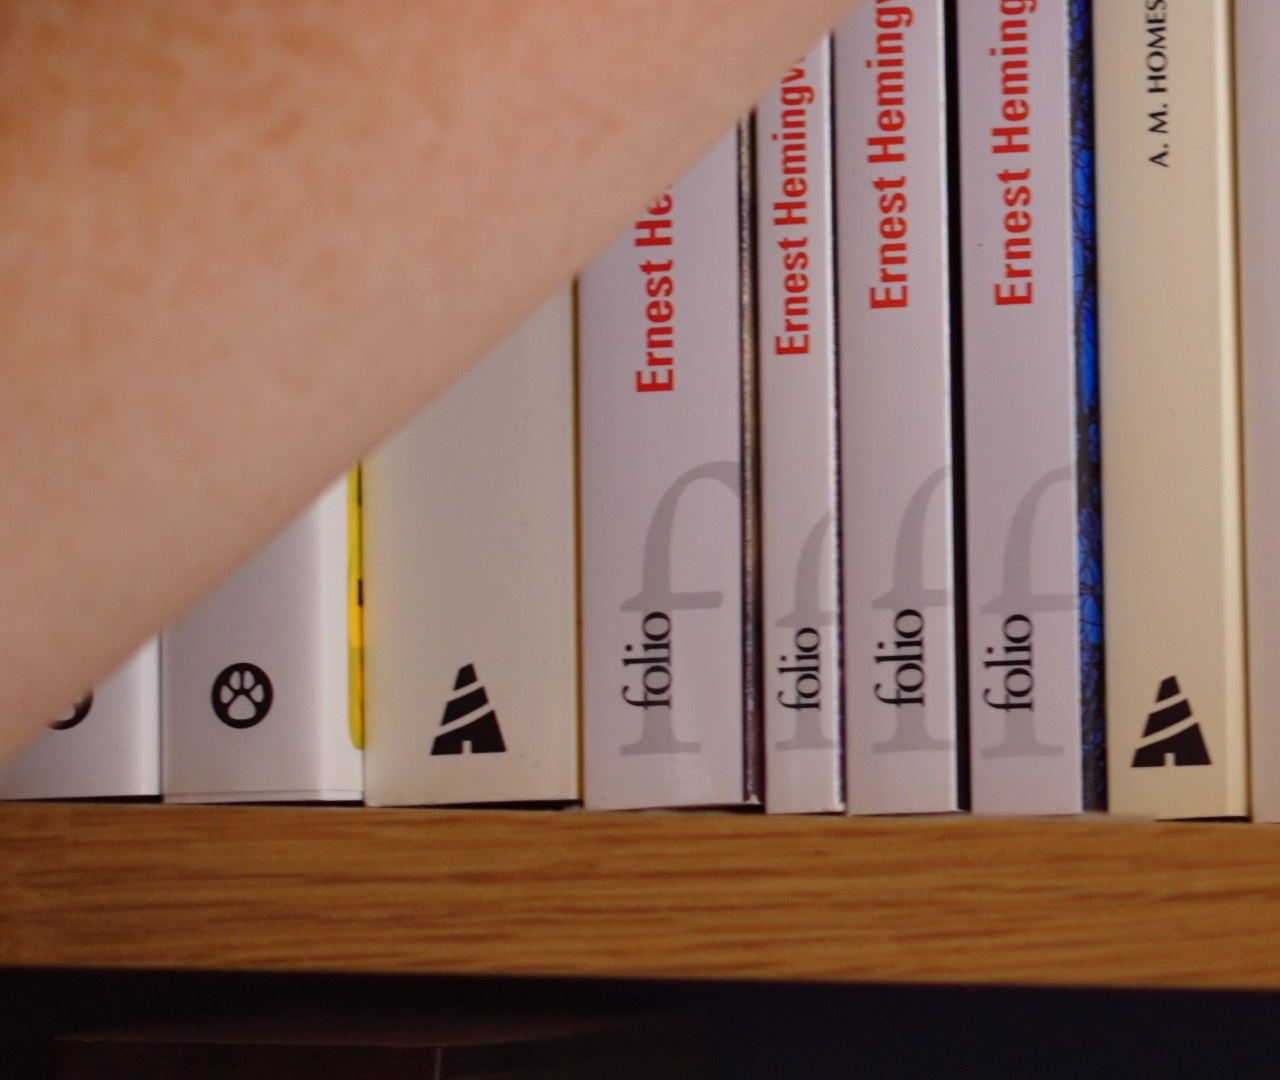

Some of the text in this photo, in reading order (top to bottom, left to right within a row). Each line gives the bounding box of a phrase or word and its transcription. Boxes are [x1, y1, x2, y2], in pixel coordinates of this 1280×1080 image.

[1148, 103, 1170, 138] M.
[1148, 147, 1170, 167] A.
[869, 177, 910, 309] Ernest
[995, 169, 1034, 305] Ernest
[635, 260, 675, 392] Ernest
[775, 237, 810, 355] Ernest
[622, 611, 673, 710] folio
[777, 627, 820, 711] folio
[874, 609, 925, 707] folio
[983, 614, 1034, 712] folio
